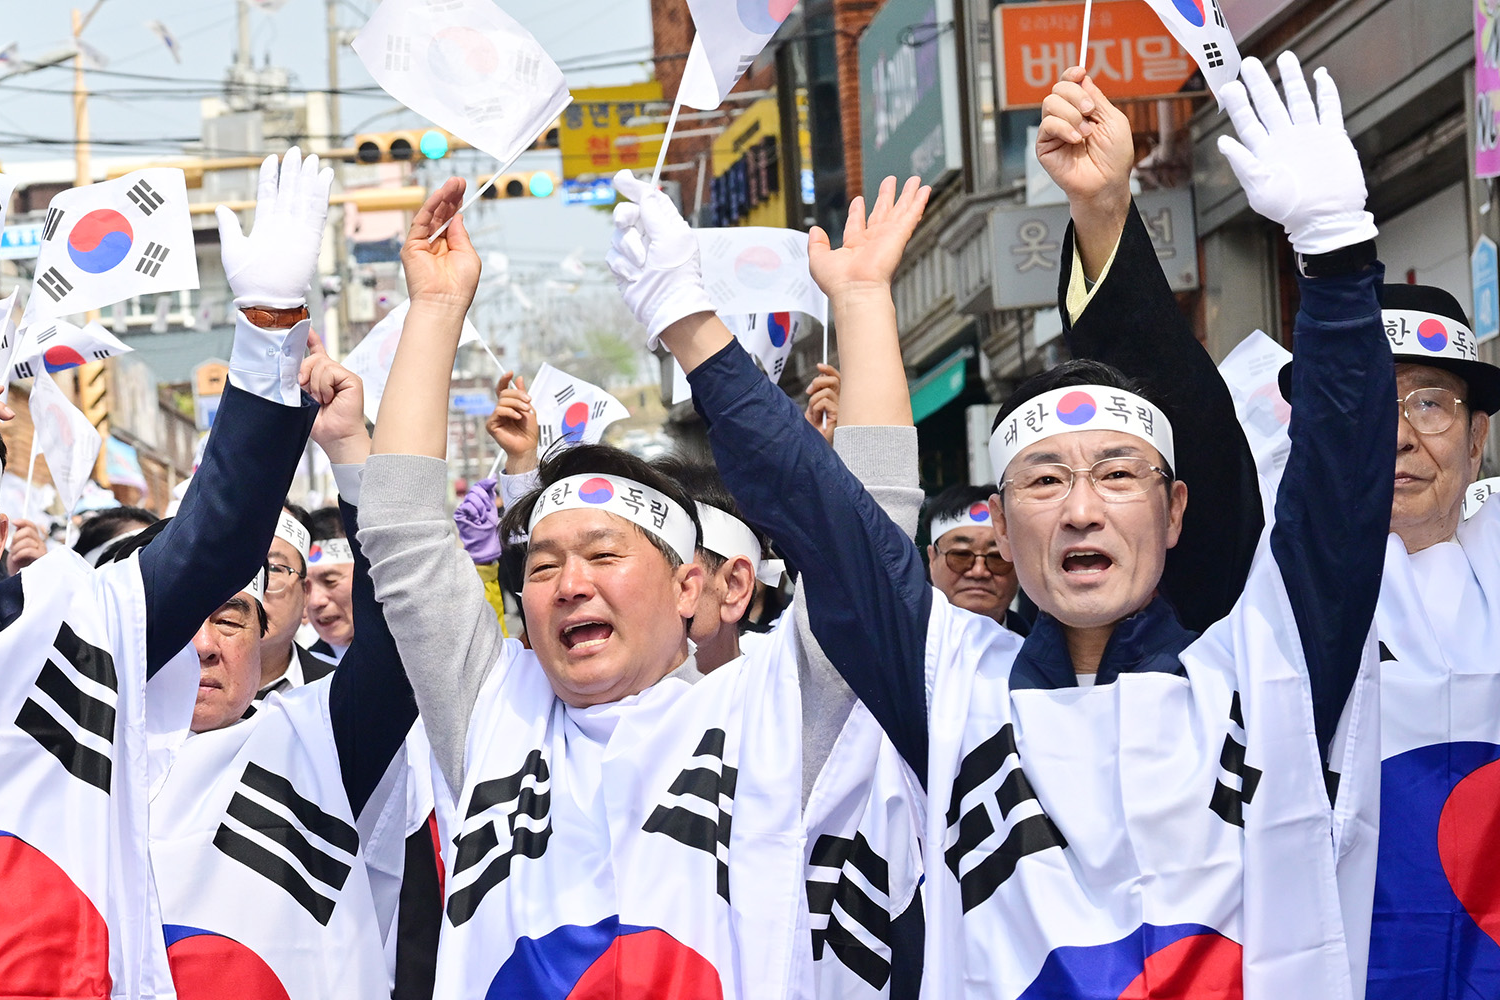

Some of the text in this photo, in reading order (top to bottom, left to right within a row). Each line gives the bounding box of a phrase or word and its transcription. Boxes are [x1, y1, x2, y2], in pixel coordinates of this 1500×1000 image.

[1021, 36, 1190, 87] 베지밀
[1010, 207, 1176, 272] 옷선
[1384, 317, 1411, 346] 한
[1004, 395, 1154, 447] 대한 독립
[534, 483, 669, 530] 대한 독립
[282, 518, 306, 549] 독립
